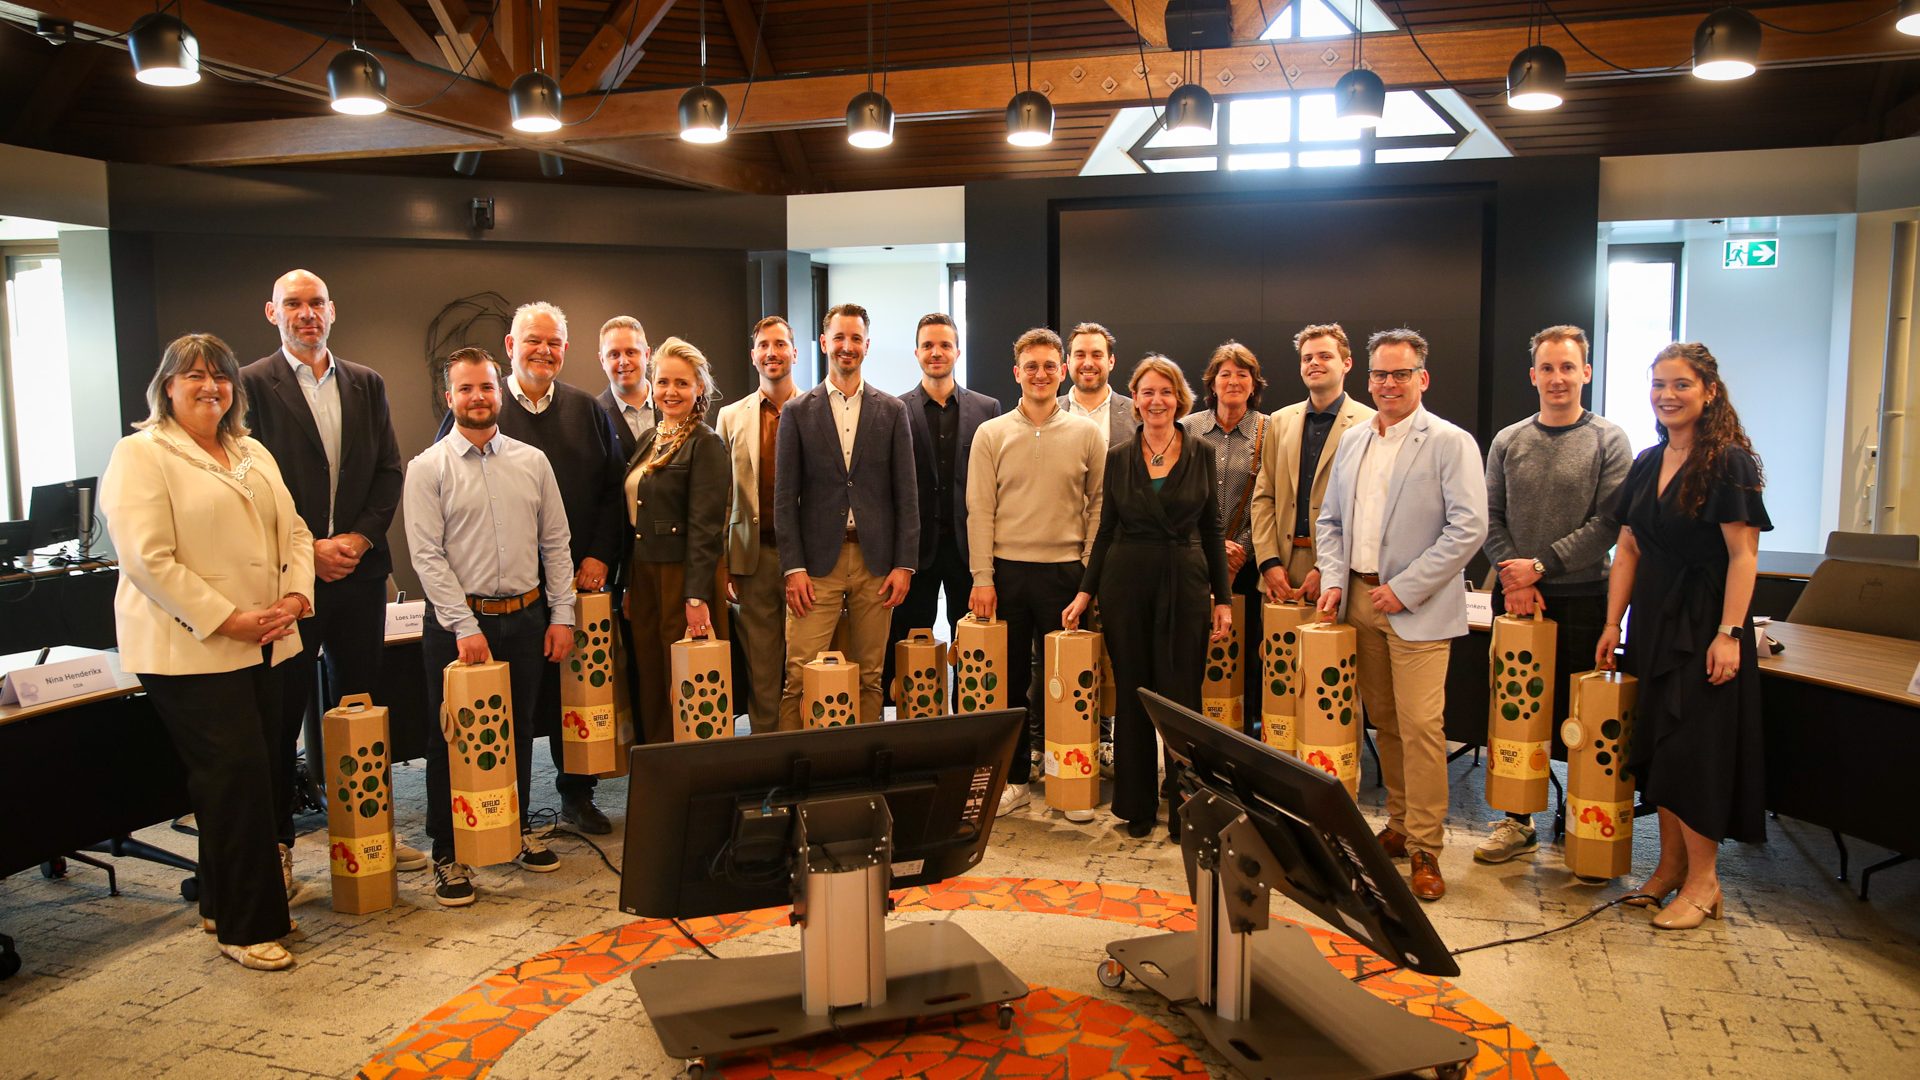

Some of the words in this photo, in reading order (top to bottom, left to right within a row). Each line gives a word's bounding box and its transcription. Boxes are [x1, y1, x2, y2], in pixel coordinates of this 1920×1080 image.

[45, 676, 64, 685] Nina
[65, 668, 102, 680] Henderikx
[485, 806, 498, 815] TREE!
[367, 852, 380, 861] TREE!
